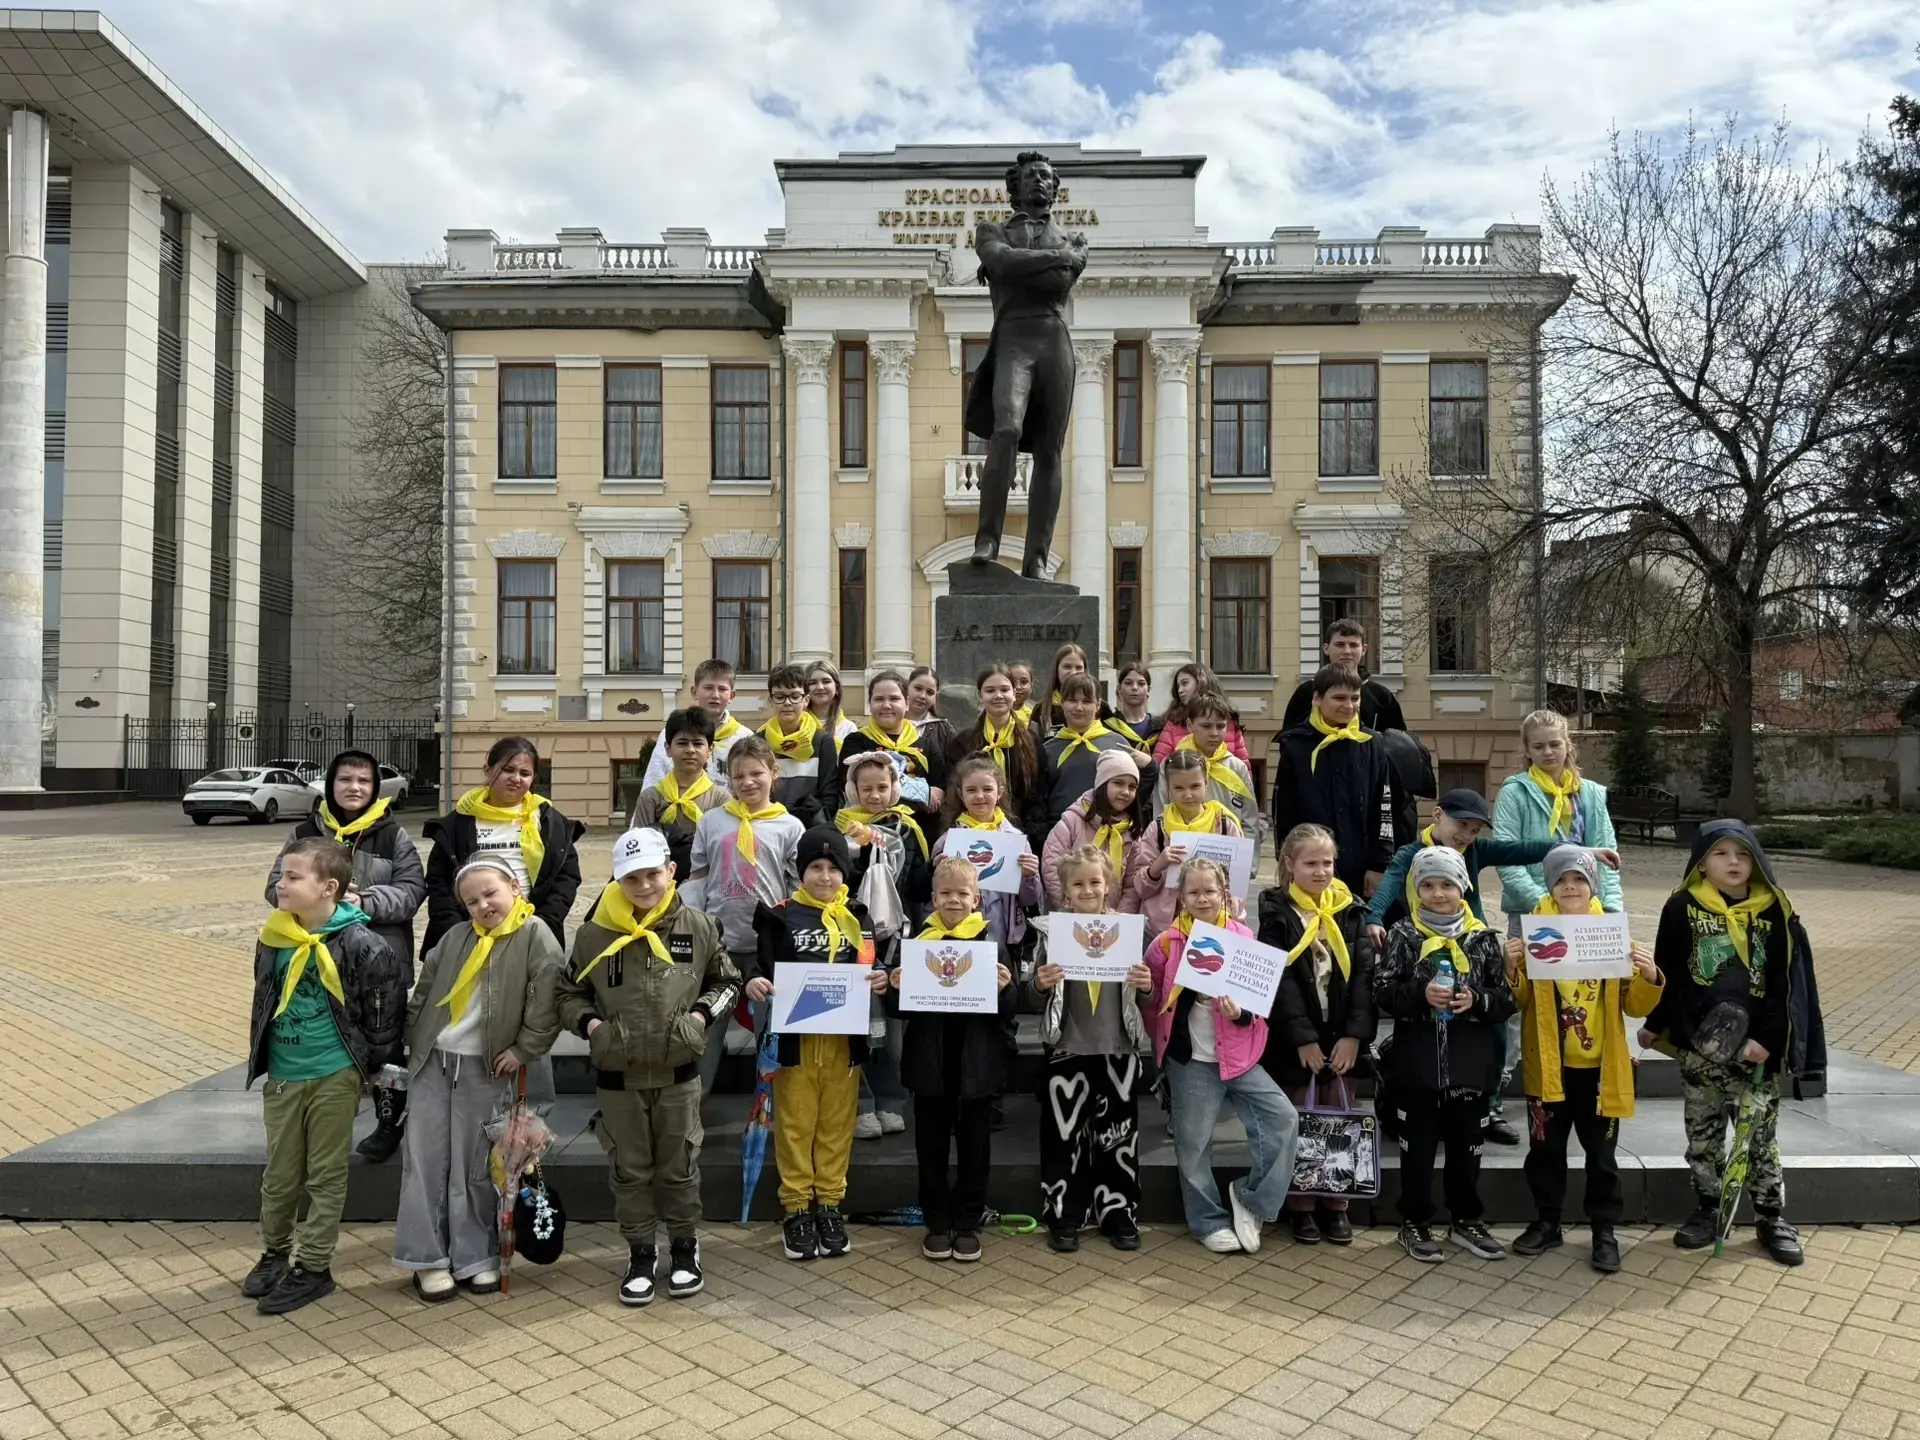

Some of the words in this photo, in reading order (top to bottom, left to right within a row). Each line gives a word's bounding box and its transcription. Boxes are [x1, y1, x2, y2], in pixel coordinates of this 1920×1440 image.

[878, 210, 965, 227] КРАЕВАЯ
[974, 209, 1099, 227] БИБТЕКА
[953, 624, 983, 641] А.С.
[992, 623, 1083, 642] ПУШКИНУ
[625, 848, 641, 857] BMW
[1686, 903, 1726, 924] NEVE
[1574, 926, 1622, 934] АГЕНТСТВО
[1574, 933, 1622, 941] РАЗВИТИЯ
[1235, 949, 1277, 968] АГЕНТСТВО
[1576, 948, 1623, 957] ТУРИЗМА
[1232, 955, 1275, 977] РАЗВИТИЯ
[1228, 970, 1270, 992] ТУРИЗМА
